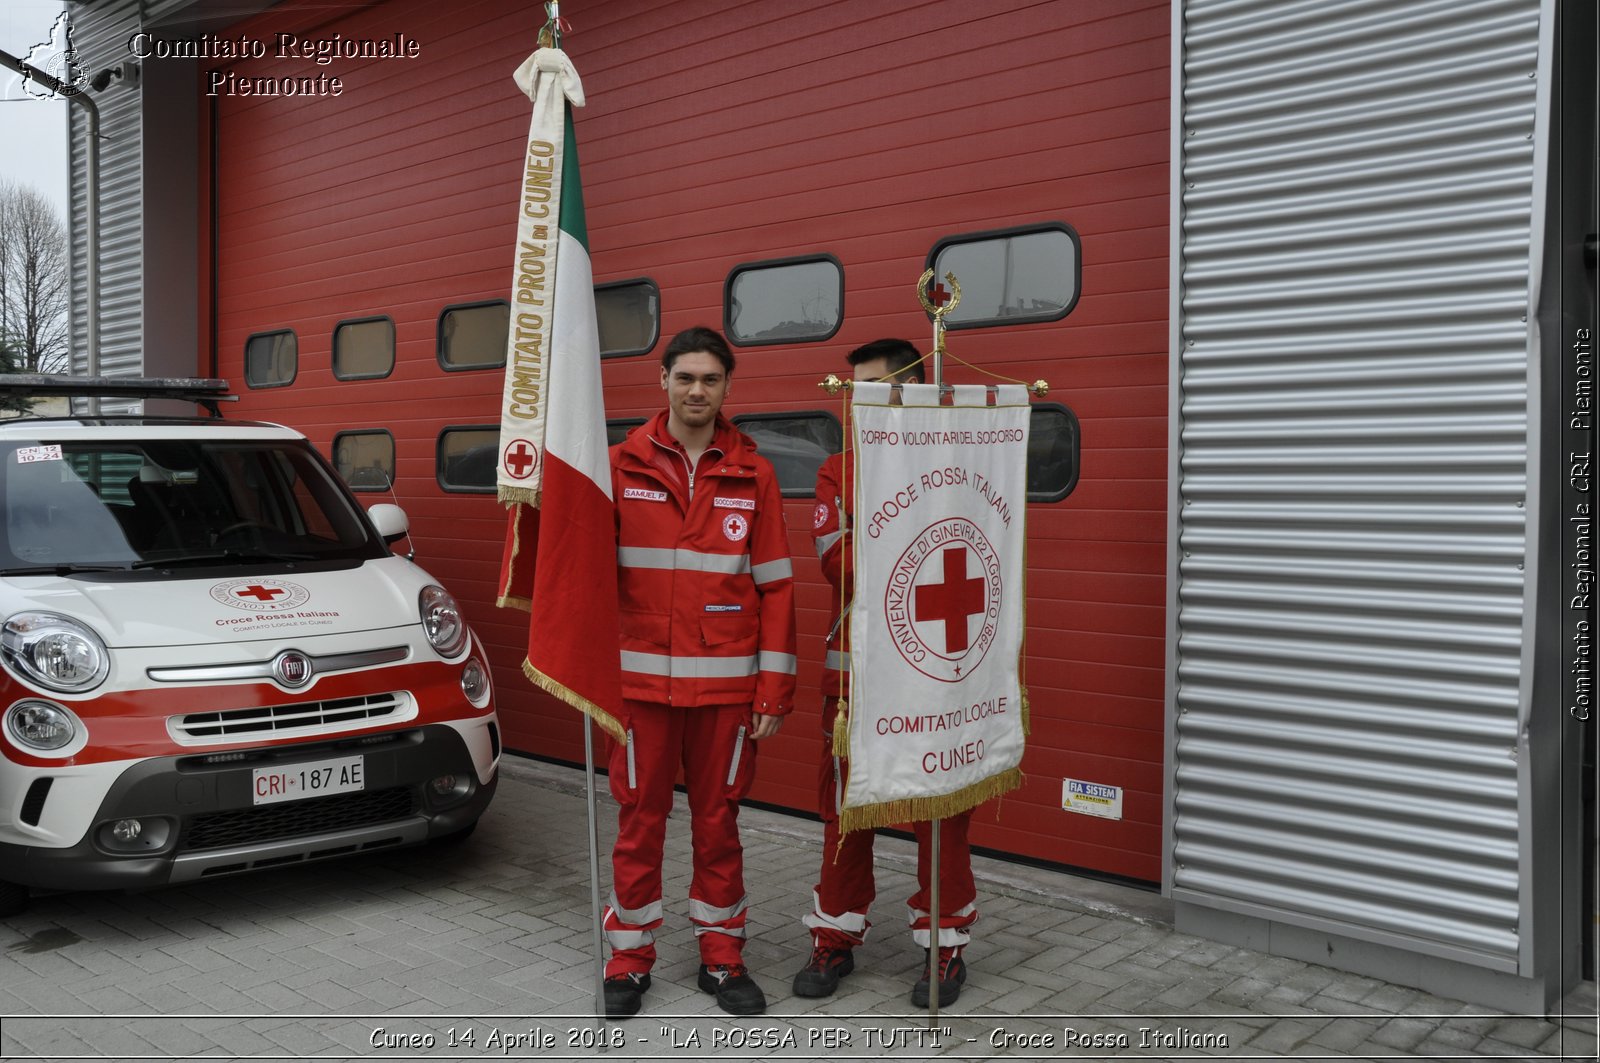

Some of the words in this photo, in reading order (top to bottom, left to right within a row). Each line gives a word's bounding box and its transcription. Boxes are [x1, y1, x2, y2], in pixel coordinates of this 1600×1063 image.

[524, 140, 554, 218] CUNEO
[532, 224, 548, 240] DI
[516, 241, 546, 307] PROV.
[509, 312, 543, 420] COMITATO
[862, 430, 899, 446] CORPO
[902, 431, 959, 446] VOLONTARI
[960, 431, 976, 444] DEL
[625, 489, 657, 499] SAMUEL
[867, 483, 919, 539] CROCE
[920, 467, 969, 493] ROSSA
[972, 472, 1012, 531] ITALIANA
[917, 536, 931, 555] DI
[930, 523, 976, 544] GINEVRA
[975, 536, 988, 556] 22
[984, 554, 1000, 619] AGOSTO
[215, 616, 253, 627] Croce
[255, 613, 295, 622] Rossa
[296, 610, 340, 619] Italiana
[889, 550, 927, 663] CONVENZIONE
[978, 622, 995, 652] 1864
[285, 661, 303, 676] FIAT
[876, 709, 962, 736] COMITATO
[964, 697, 1007, 723] LOCALE
[922, 739, 985, 774] CUNEO
[256, 773, 286, 797] CRI
[299, 767, 333, 792] 187
[340, 763, 361, 786] AE
[1070, 782, 1083, 793] FIA
[1085, 784, 1115, 799] SISTEM
